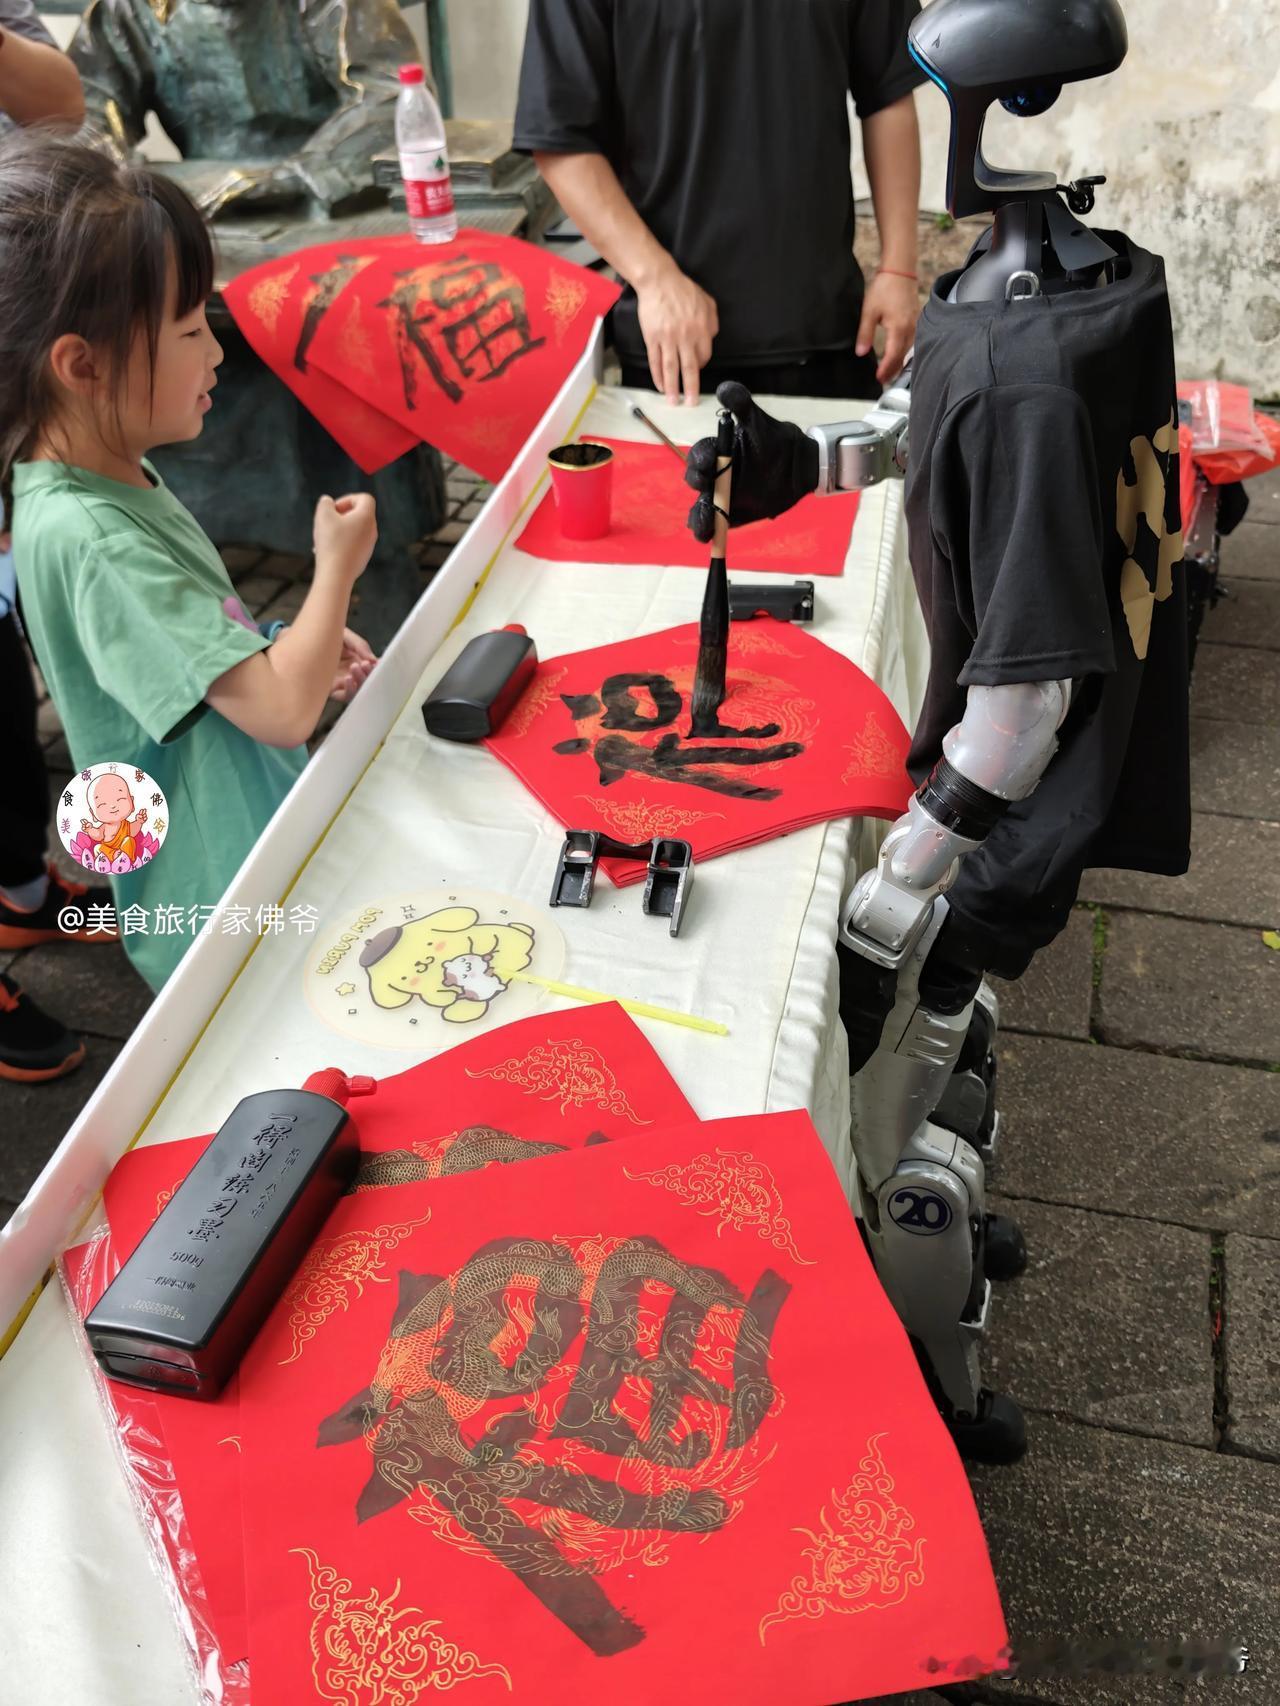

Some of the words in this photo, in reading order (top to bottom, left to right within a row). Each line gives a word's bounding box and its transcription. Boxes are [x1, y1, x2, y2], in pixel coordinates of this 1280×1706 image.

[376, 254, 547, 411] 福
[894, 1190, 948, 1230] 20
[169, 1250, 206, 1270] 500g
[316, 1235, 793, 1657] 福
